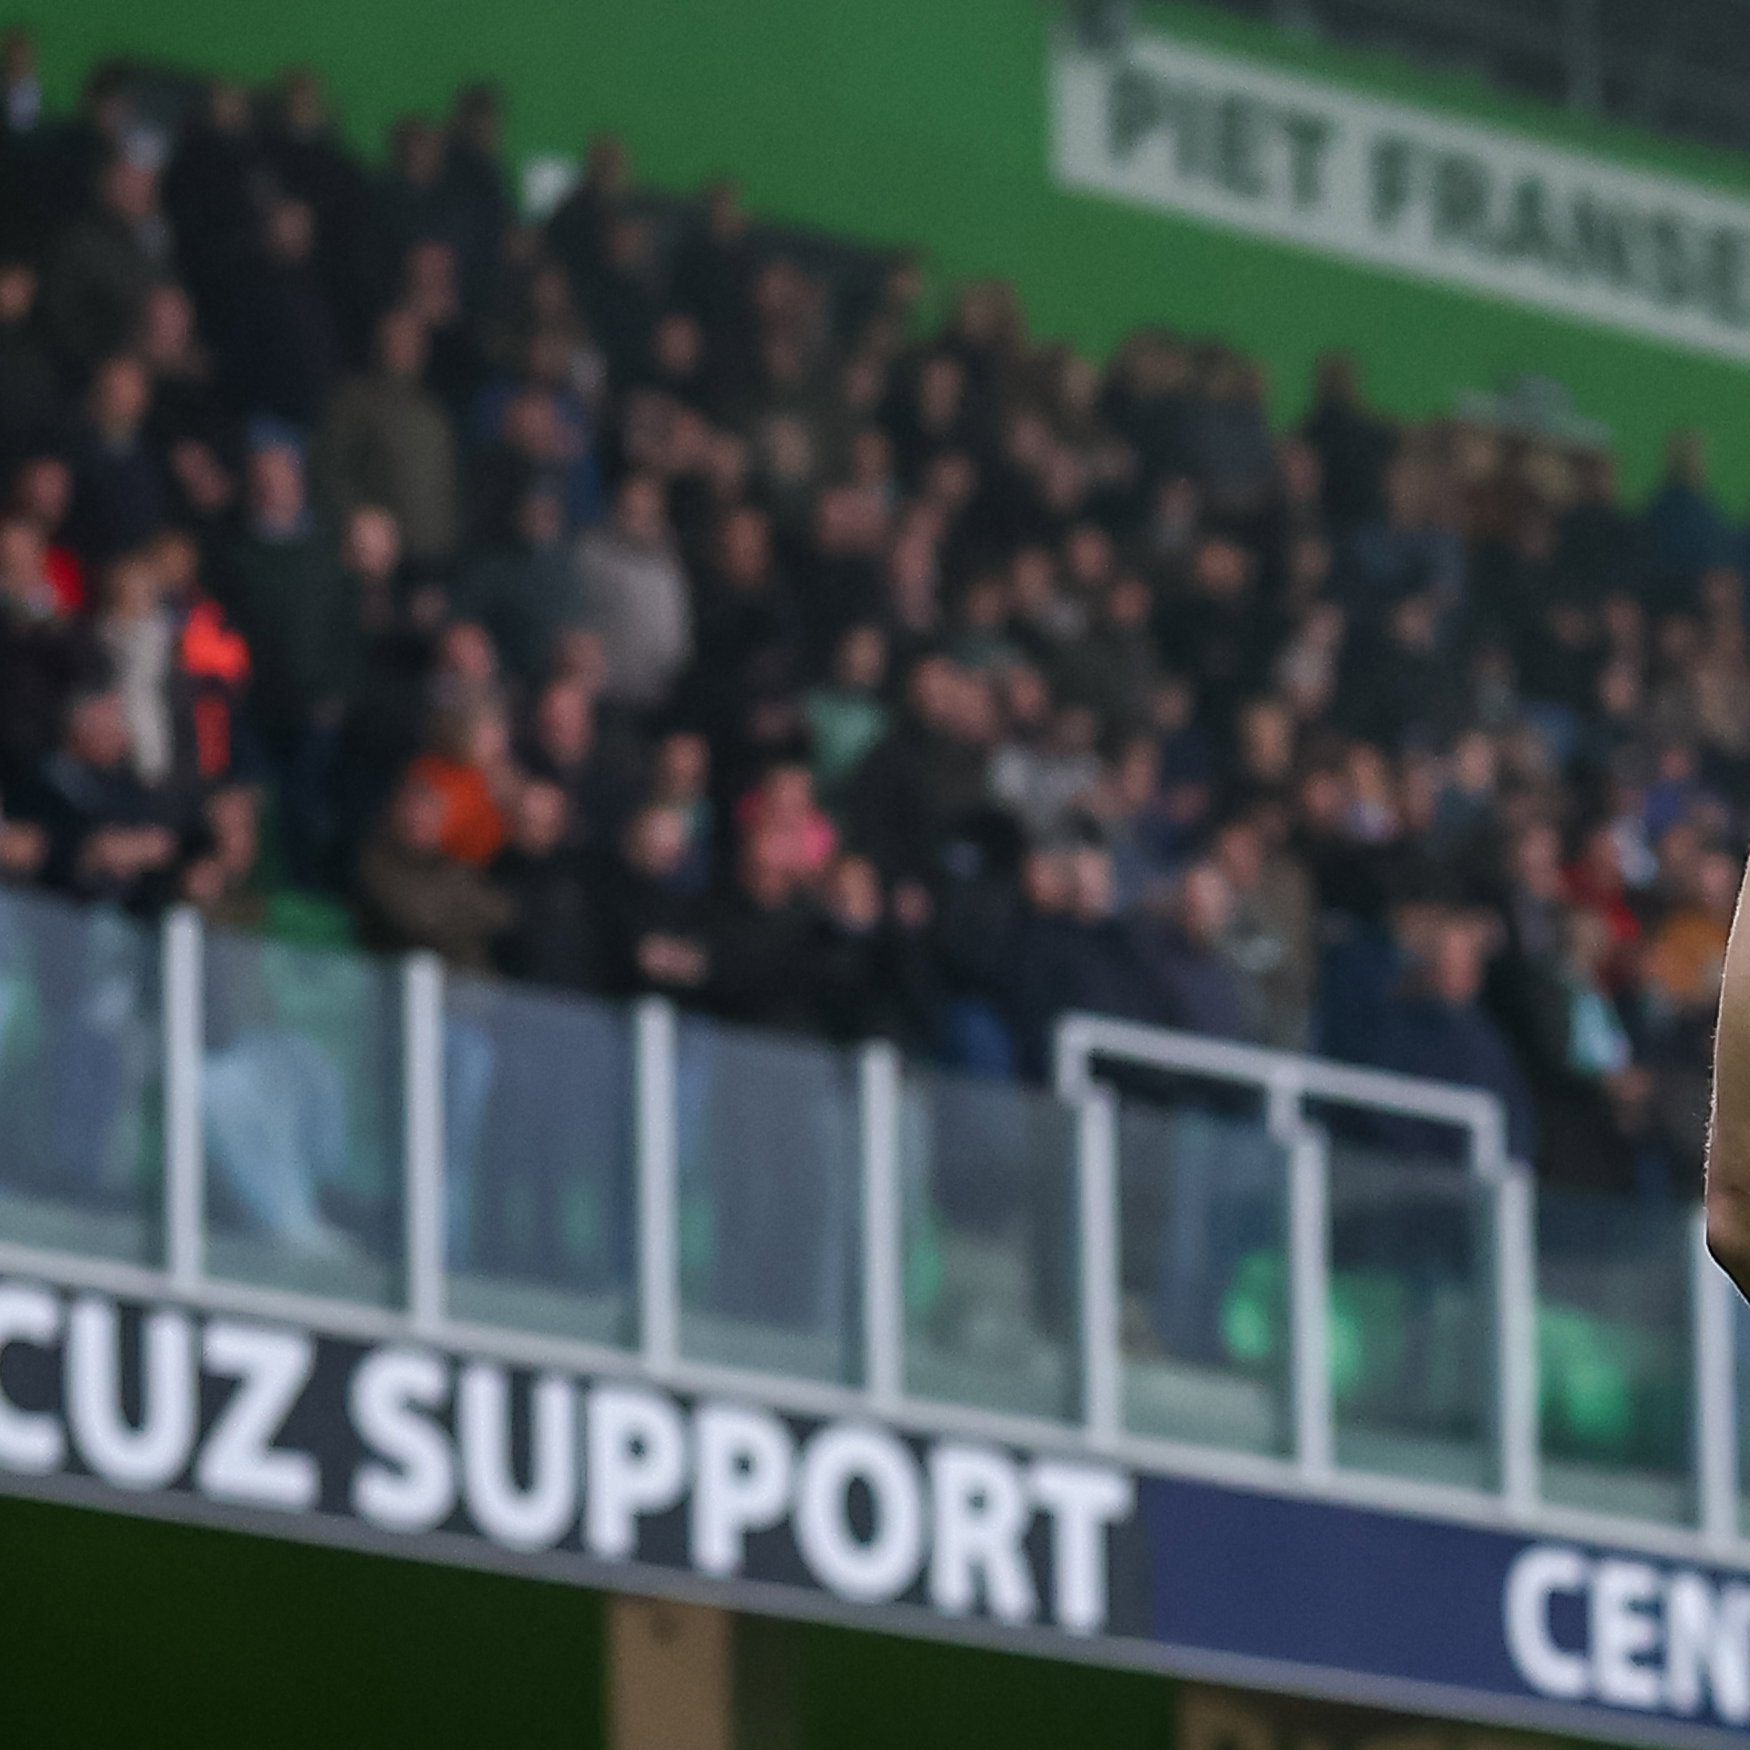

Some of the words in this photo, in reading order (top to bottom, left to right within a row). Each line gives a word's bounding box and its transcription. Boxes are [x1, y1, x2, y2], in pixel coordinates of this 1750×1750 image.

[1104, 66, 1334, 208] PIET
[0, 1282, 320, 1514] CUZ
[349, 1350, 1134, 1636] SUPPORT
